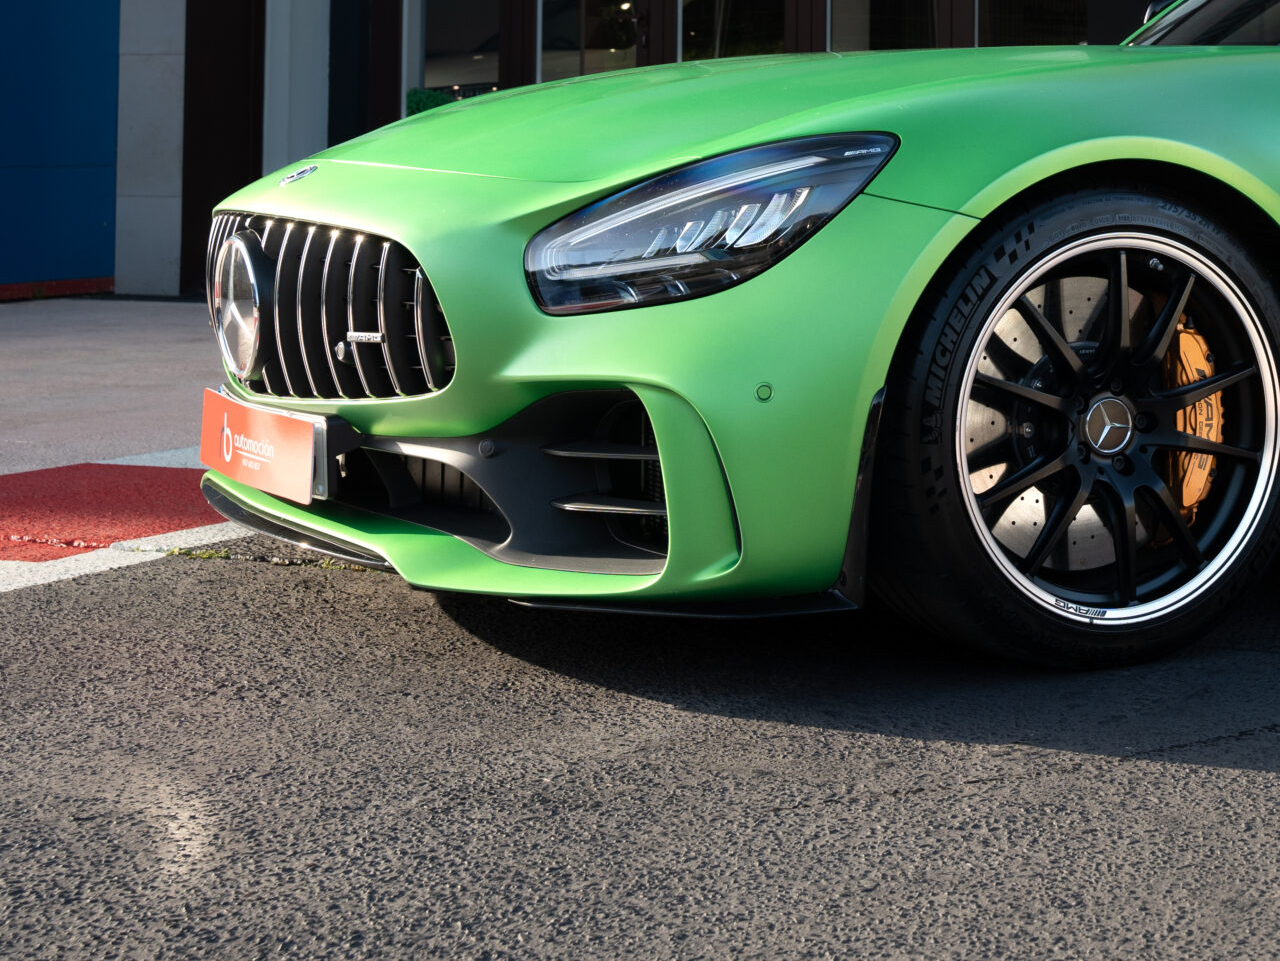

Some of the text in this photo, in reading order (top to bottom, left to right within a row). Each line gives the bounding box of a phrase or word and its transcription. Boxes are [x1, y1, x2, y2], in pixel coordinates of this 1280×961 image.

[925, 267, 991, 407] MICHELIN
[234, 432, 275, 459] automoción
[1054, 599, 1090, 616] AMG
